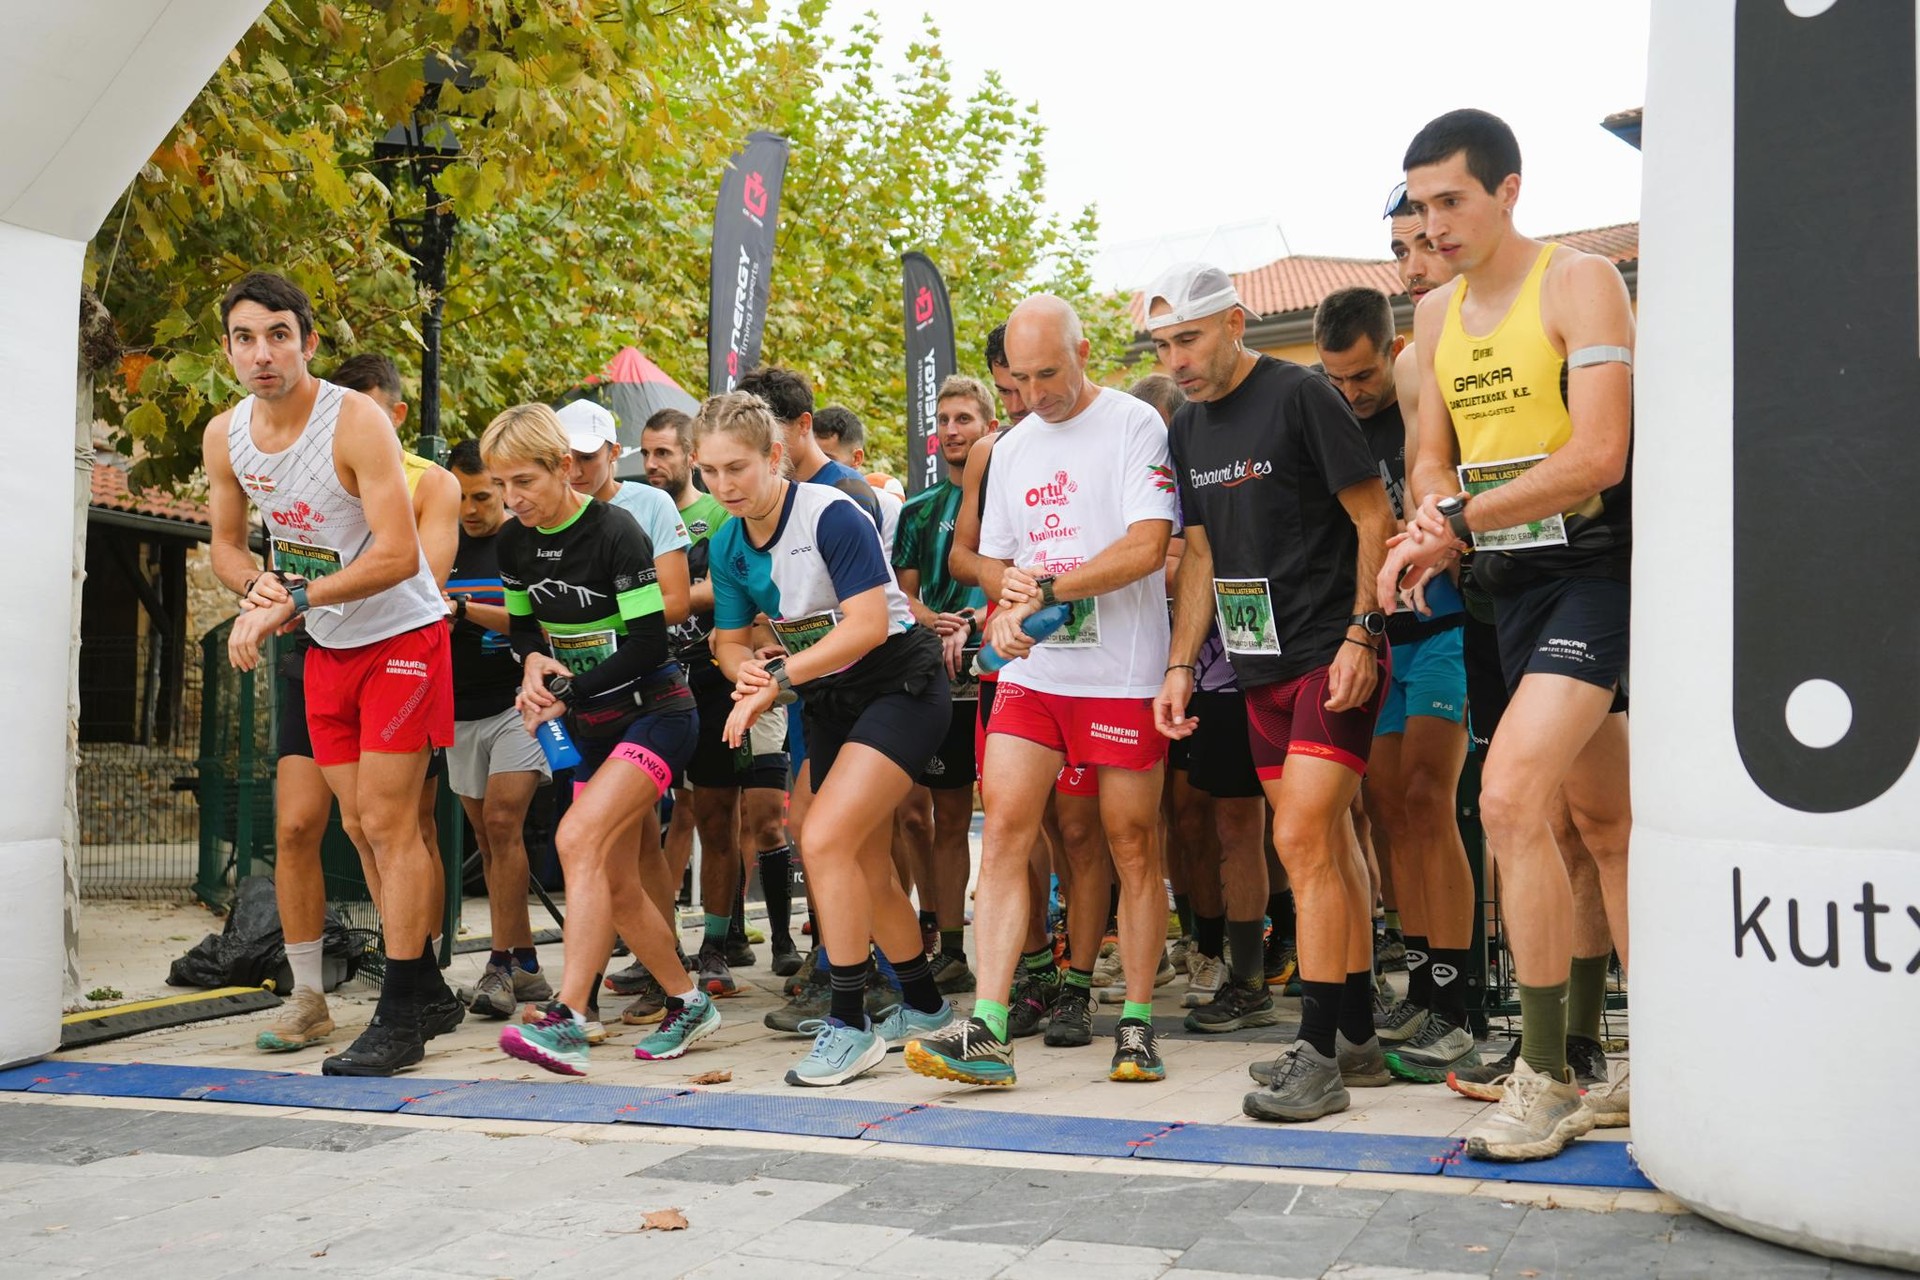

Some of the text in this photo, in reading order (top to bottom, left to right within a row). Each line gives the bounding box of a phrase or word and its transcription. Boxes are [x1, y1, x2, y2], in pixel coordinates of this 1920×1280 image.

[727, 244, 751, 394] RONERGY
[739, 261, 759, 357] Timing Experts
[1454, 367, 1514, 392] GAIKAR
[1190, 464, 1232, 489] Basauri
[1025, 483, 1062, 507] Ortu
[1226, 605, 1260, 632] 142
[1548, 638, 1587, 650] GAIKAR
[1091, 722, 1139, 738] AIARAMENDI
[1732, 866, 1920, 975] kut
